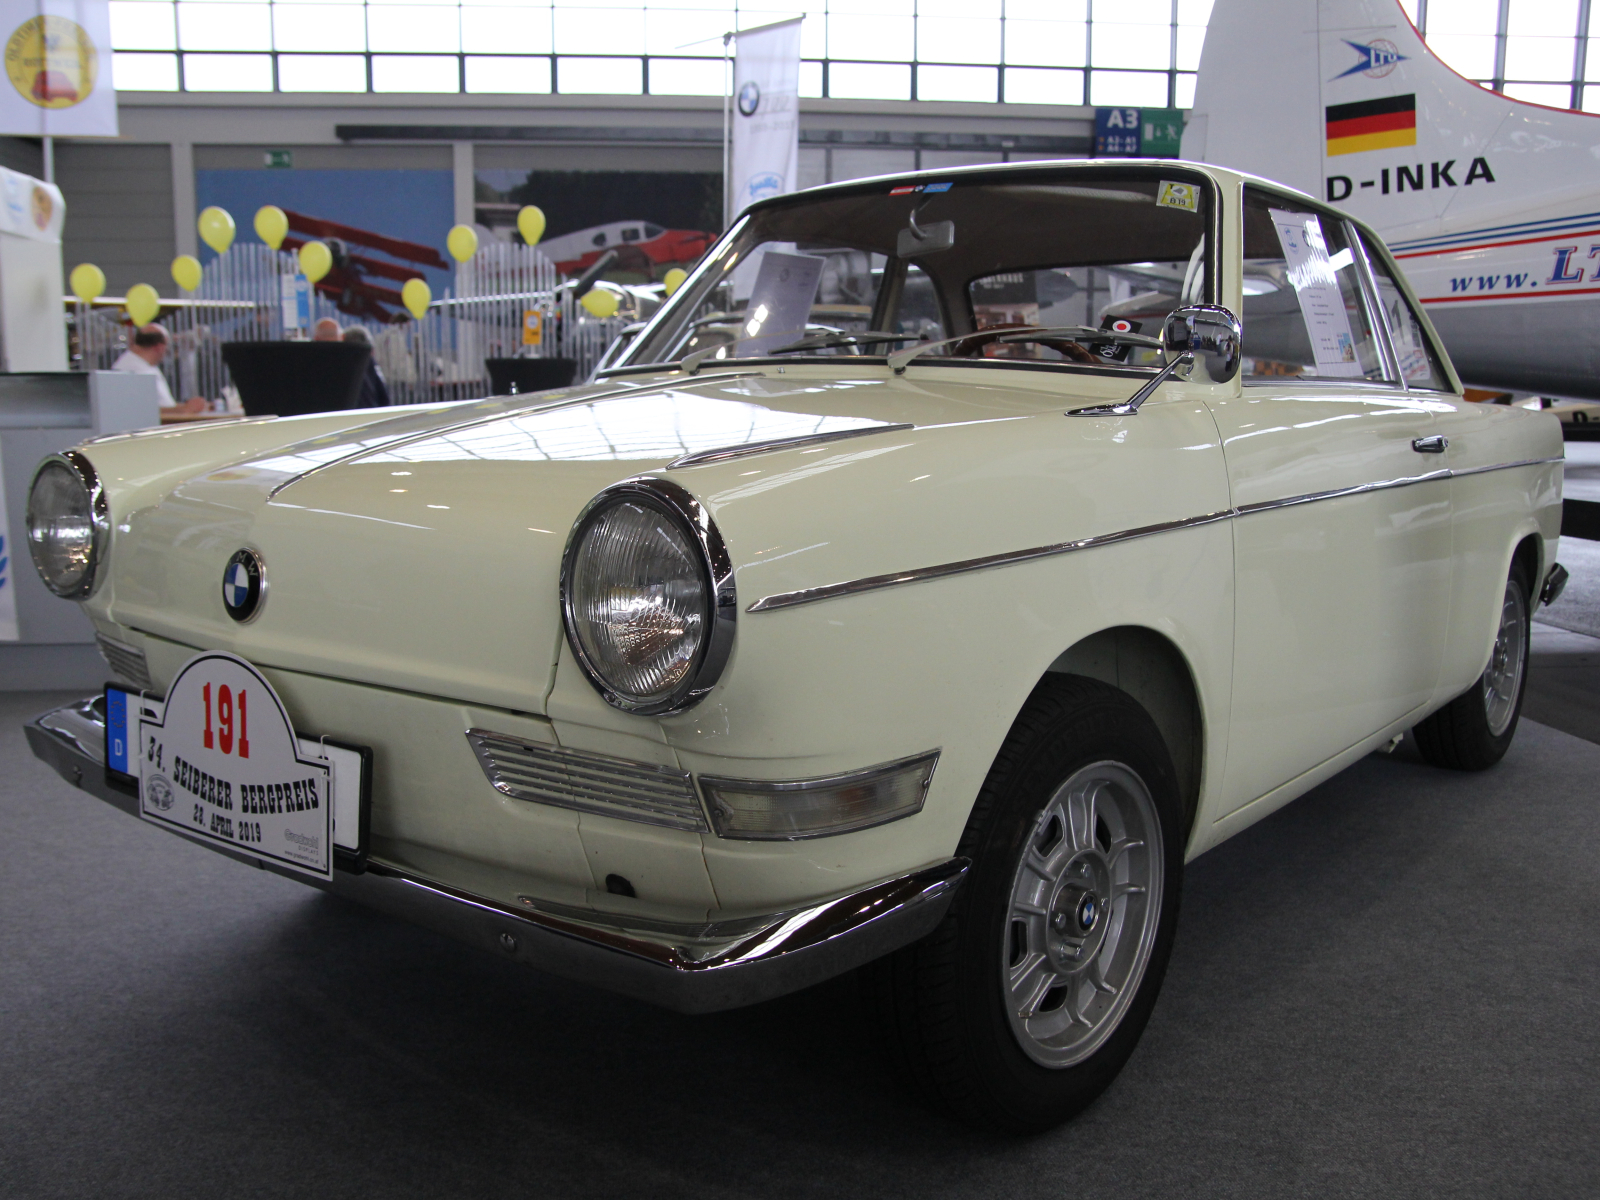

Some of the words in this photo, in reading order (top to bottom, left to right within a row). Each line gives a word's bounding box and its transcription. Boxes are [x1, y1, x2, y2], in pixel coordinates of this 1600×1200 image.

[1370, 48, 1398, 68] LTU
[1106, 109, 1138, 129] A3
[1326, 156, 1496, 203] D-INKA
[203, 682, 249, 759] 191
[114, 738, 123, 756] D
[148, 735, 166, 773] 34.
[173, 755, 234, 811] SEIBERER
[240, 777, 320, 815] BERGPREIS
[210, 812, 234, 839] APRIL
[239, 821, 262, 843] 2019
